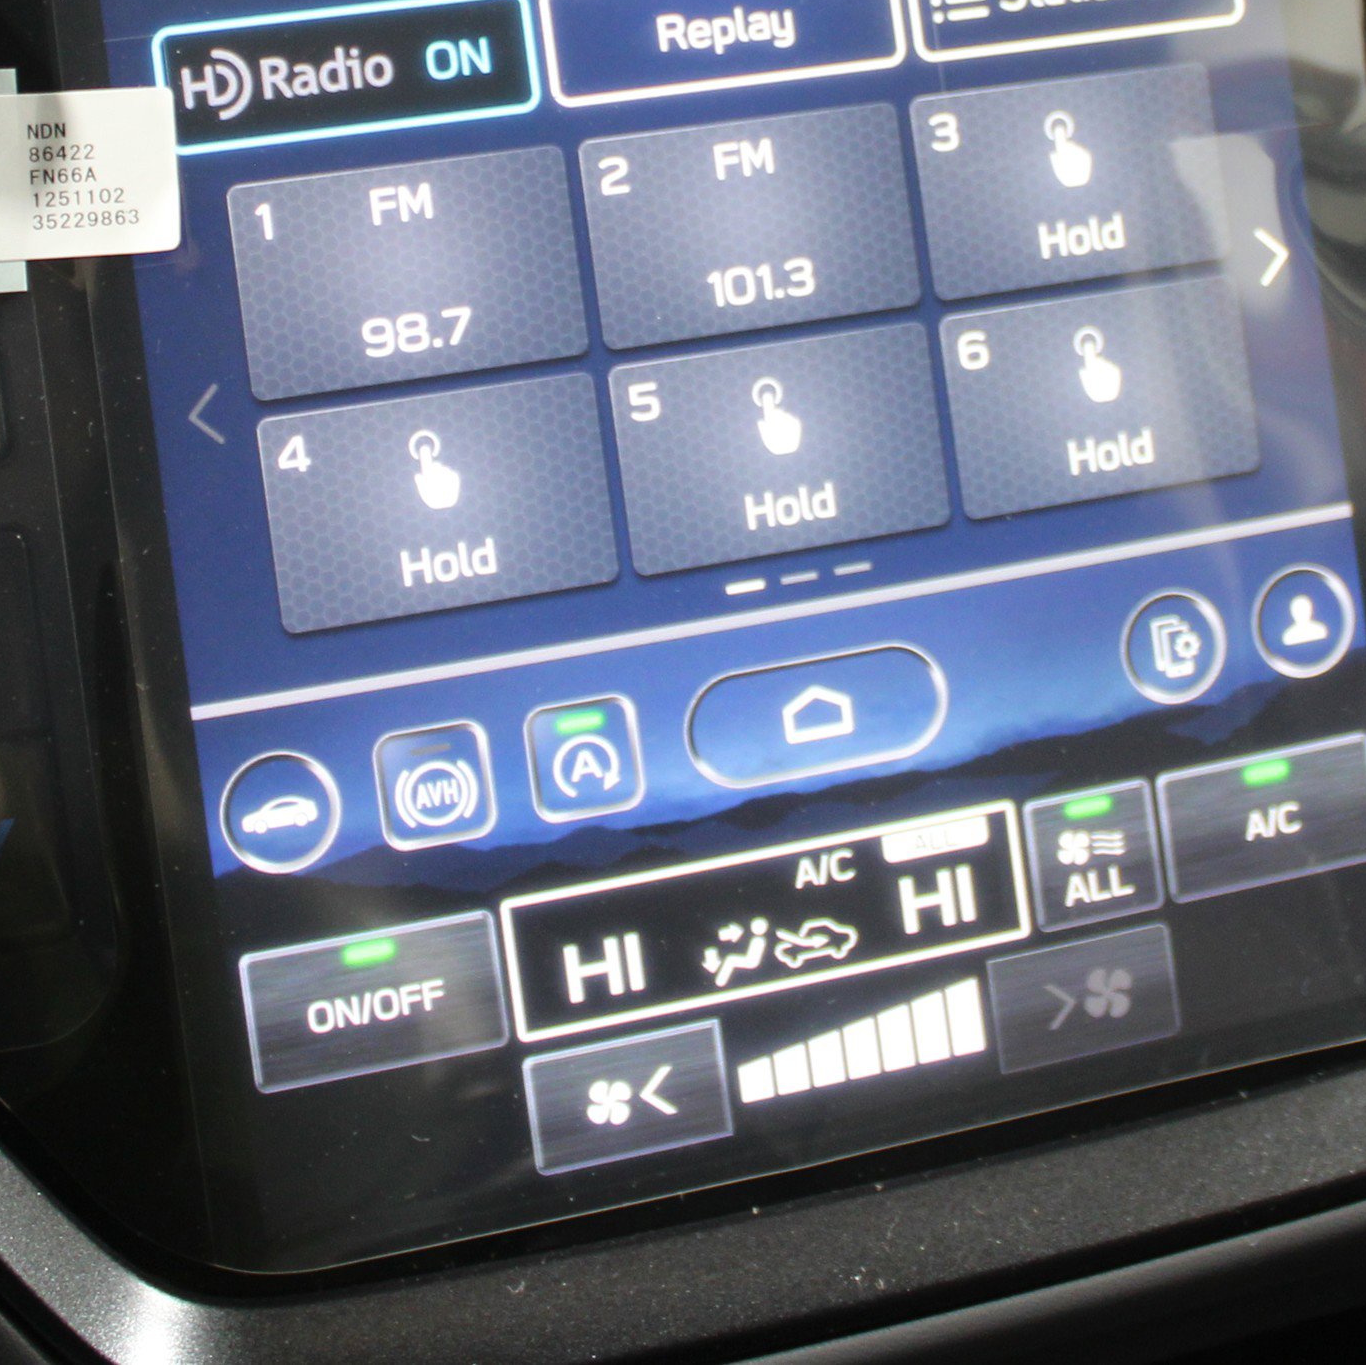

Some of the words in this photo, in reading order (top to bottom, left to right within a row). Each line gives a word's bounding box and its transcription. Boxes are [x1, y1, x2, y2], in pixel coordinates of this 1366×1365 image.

[656, 7, 795, 49] Replay
[259, 46, 394, 101] Radio
[425, 36, 493, 81] ON
[26, 123, 67, 140] NDN
[928, 112, 960, 152] 3
[28, 143, 96, 163] 86422
[712, 138, 775, 181] FM
[29, 167, 97, 185] FN66A
[597, 156, 631, 196] 2
[33, 187, 125, 208] 1251102
[369, 182, 434, 226] FM
[32, 209, 140, 231] 35229863
[254, 203, 274, 241] 1
[1037, 213, 1126, 260] Hold
[706, 257, 815, 308] 101.3
[361, 306, 472, 358] 98.7
[957, 331, 990, 370] 6
[628, 381, 661, 422] 5
[277, 434, 312, 473] 4
[1066, 428, 1155, 476] Hold
[744, 481, 837, 531] Hold
[399, 536, 498, 587] Hold
[416, 778, 459, 810] AVH
[1245, 801, 1302, 842] A/C
[795, 848, 857, 889] A/C
[1064, 866, 1135, 908] ALL
[897, 863, 977, 935] HI
[562, 932, 646, 1004] HI
[307, 977, 445, 1034] ON/OFF
